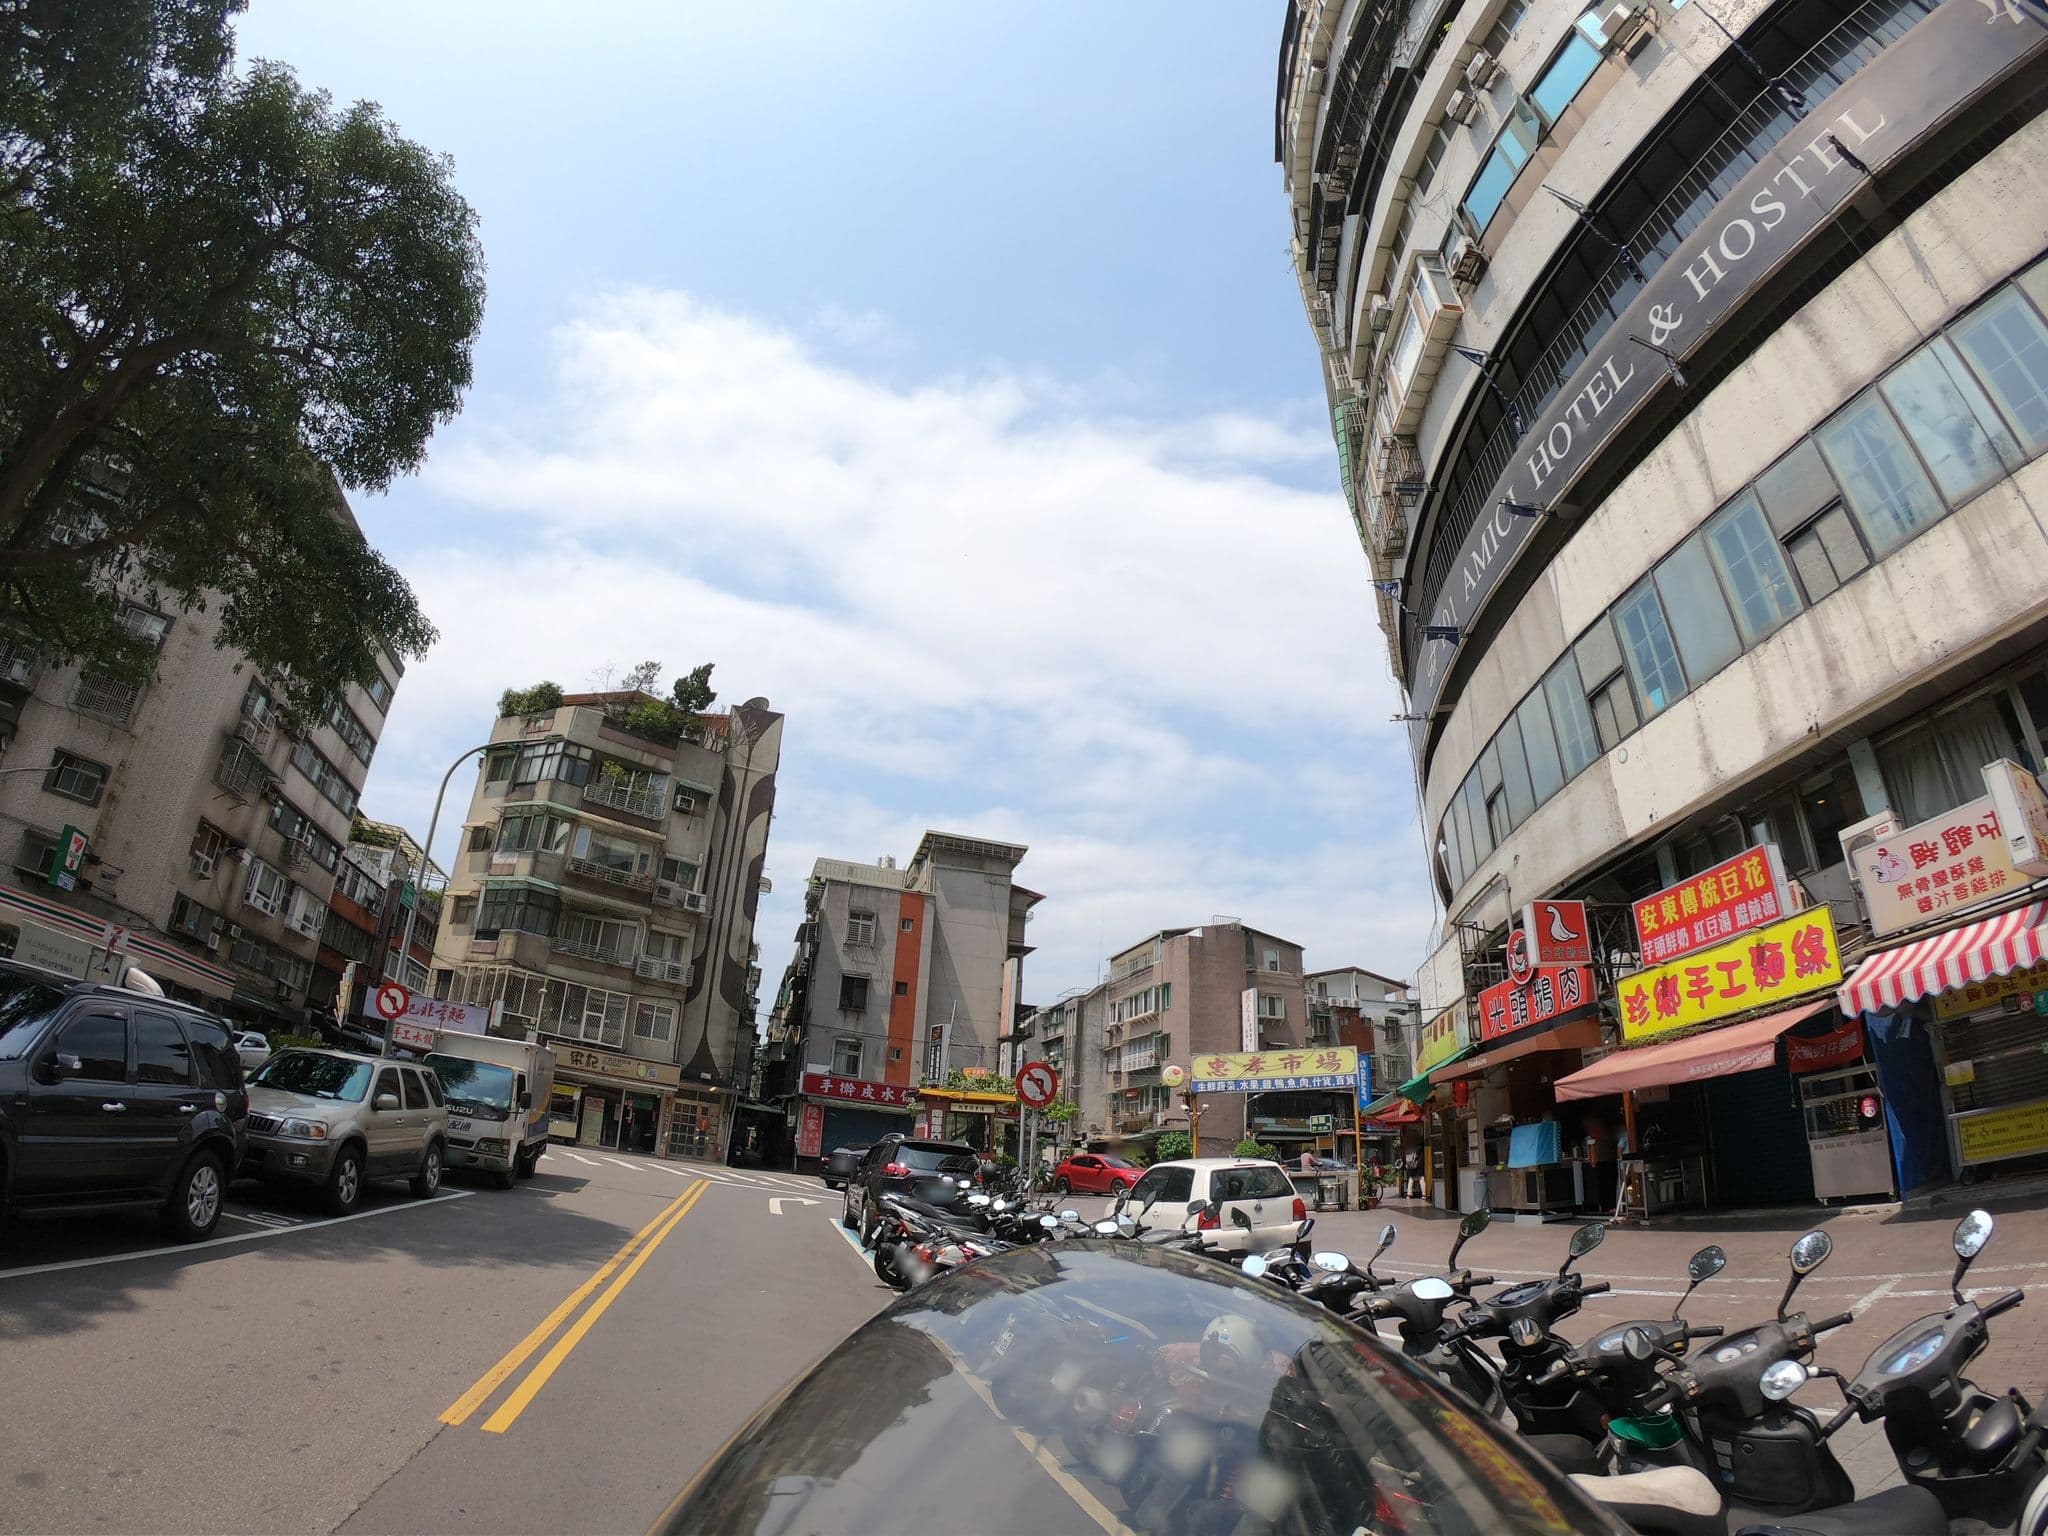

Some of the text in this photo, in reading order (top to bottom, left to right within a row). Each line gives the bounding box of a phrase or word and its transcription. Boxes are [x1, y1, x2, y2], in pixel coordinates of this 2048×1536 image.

[1526, 354, 1635, 491] HOTEL
[1648, 302, 1683, 346] &
[1681, 108, 1886, 303] HOSTEL
[1639, 855, 1767, 935] 安東傳統豆花
[1488, 966, 1581, 1036] 光頭鵝肉
[1206, 1051, 1342, 1078] 忠孝市場
[445, 1104, 473, 1115] SUZU
[448, 1119, 473, 1132] 配通
